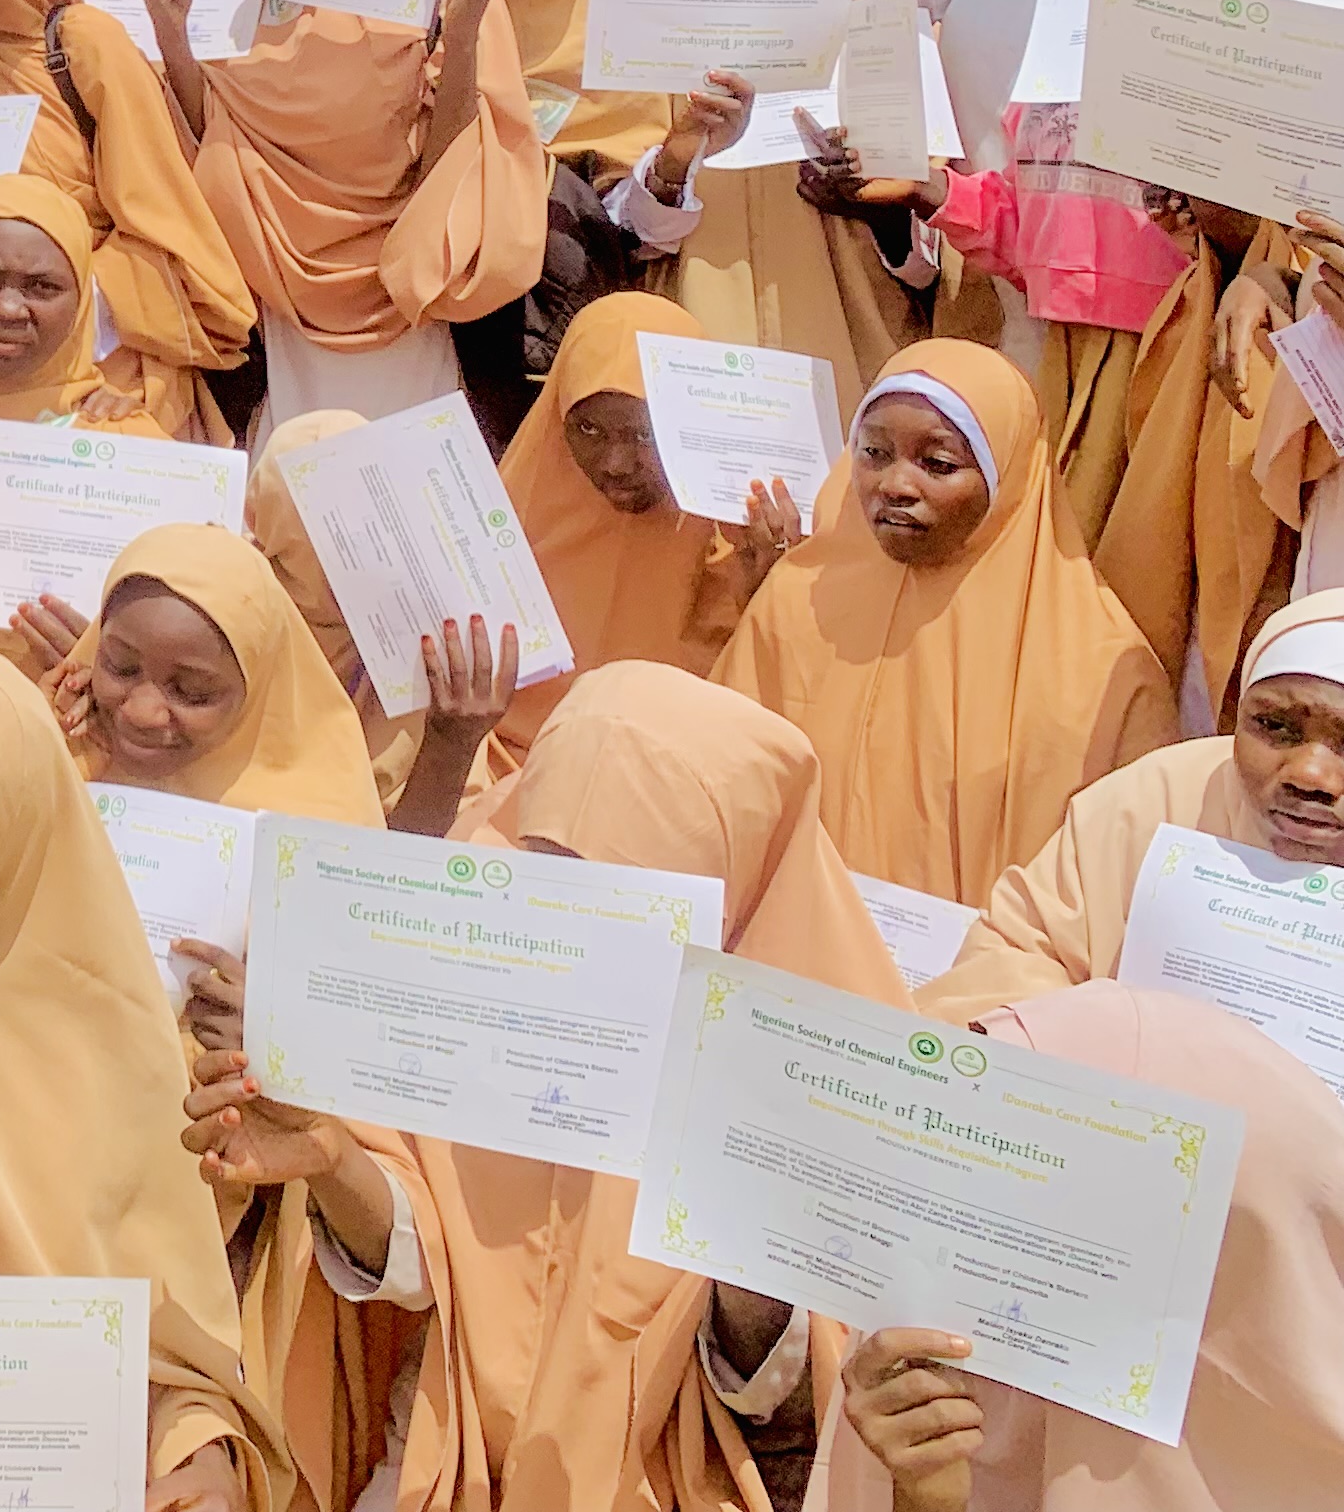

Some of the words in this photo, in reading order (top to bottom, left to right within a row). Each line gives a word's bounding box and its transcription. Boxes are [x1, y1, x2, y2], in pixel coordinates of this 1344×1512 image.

[1150, 26, 1211, 54] Certificate
[1216, 46, 1228, 58] of
[1233, 47, 1323, 81] Participation
[68, 484, 79, 496] of
[316, 861, 353, 879] Nigerian
[355, 869, 386, 886] Society
[387, 874, 397, 884] of
[398, 875, 438, 892] Chemical
[440, 884, 483, 899] Engineers
[348, 902, 437, 935] Certificate
[442, 922, 460, 937] of
[467, 922, 585, 958] Participation
[1208, 898, 1279, 929] Certificate
[1282, 921, 1300, 933] of
[751, 1008, 795, 1032] Nigerian
[797, 1025, 832, 1047] Society
[835, 1039, 846, 1049] of
[848, 1042, 895, 1066] Chemical
[898, 1058, 949, 1084] Engineers
[785, 1060, 888, 1112] Certificate
[895, 1104, 917, 1121] of
[924, 1105, 1065, 1169] Participation
[1056, 1108, 1081, 1124] Care
[1085, 1116, 1147, 1143] Foundation
[807, 1095, 876, 1126] Empowerment
[919, 1134, 945, 1151] Skills
[947, 1139, 1002, 1168] Acquisition
[1005, 1161, 1048, 1183] Program
[876, 1135, 912, 1153] PROUDLY
[914, 1145, 960, 1169] PRESENTED
[962, 1163, 973, 1172] TO
[816, 1212, 859, 1234] Production
[861, 1229, 869, 1238] of
[818, 1201, 861, 1223] Production
[863, 1218, 871, 1227] of
[953, 1263, 998, 1284] Production
[999, 1279, 1009, 1287] of
[955, 1252, 1000, 1272] Production
